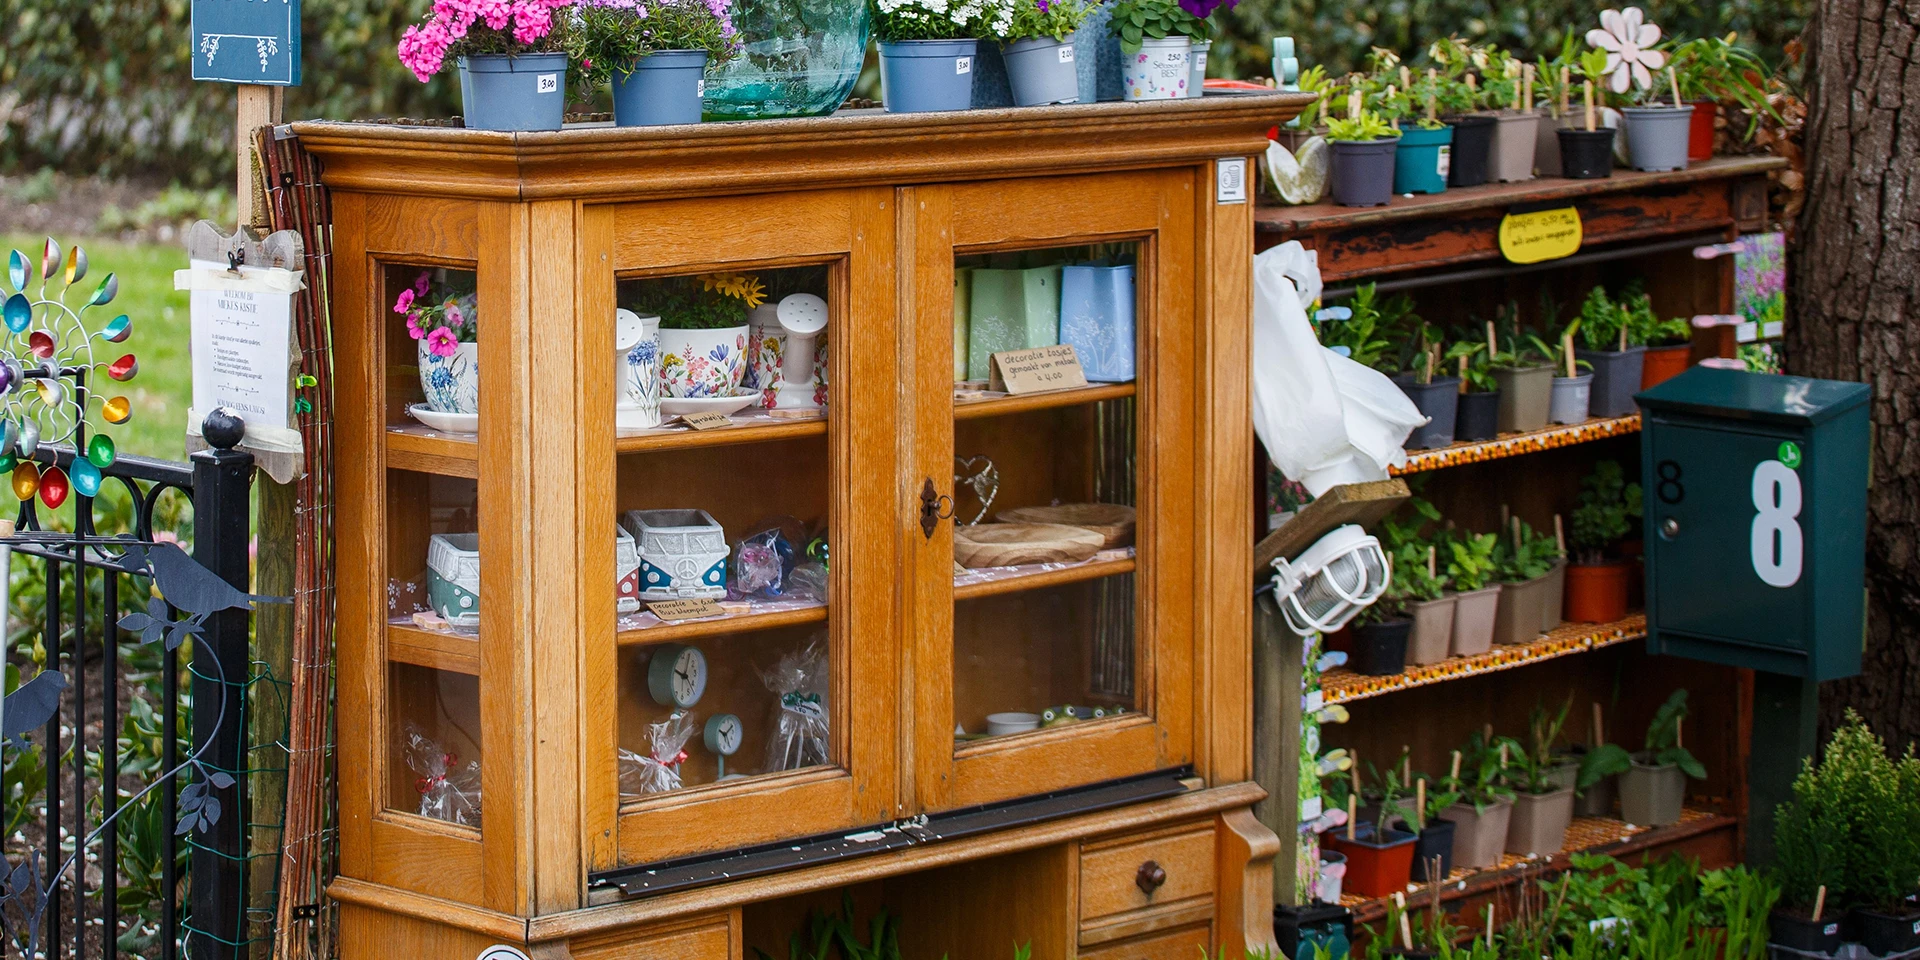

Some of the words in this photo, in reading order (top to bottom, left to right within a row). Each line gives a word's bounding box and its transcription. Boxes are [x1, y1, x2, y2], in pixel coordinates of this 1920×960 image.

[541, 78, 555, 90] 3.00
[1005, 352, 1044, 364] decoratie
[1047, 347, 1072, 359] tasjes
[1009, 363, 1039, 378] gemaakt
[1045, 371, 1063, 382] 4.00
[1658, 460, 1683, 503] 8
[1752, 460, 1802, 587] 8
[653, 600, 687, 609] Decoratie
